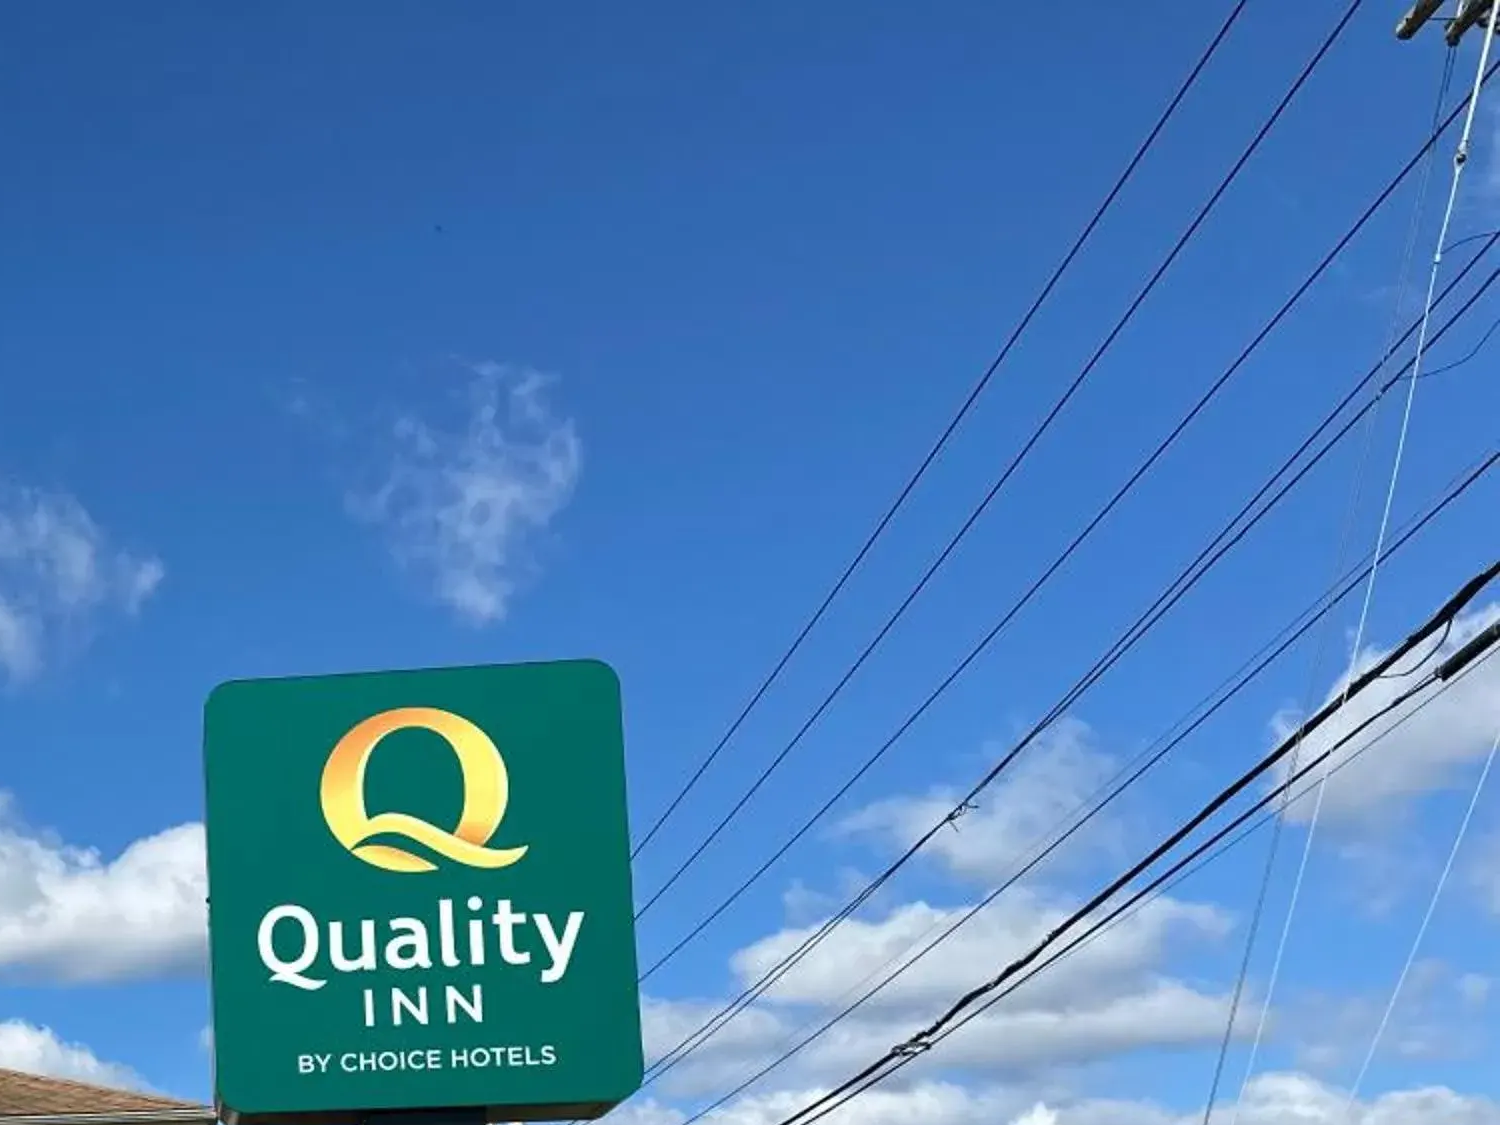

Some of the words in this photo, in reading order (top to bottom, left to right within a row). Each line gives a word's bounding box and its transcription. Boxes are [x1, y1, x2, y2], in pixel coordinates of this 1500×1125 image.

[320, 707, 530, 872] Q
[257, 896, 585, 991] Quality
[362, 984, 484, 1027] INN
[298, 1053, 332, 1074] BY
[341, 1049, 442, 1072] CHOICE
[451, 1045, 557, 1068] HOTELS
